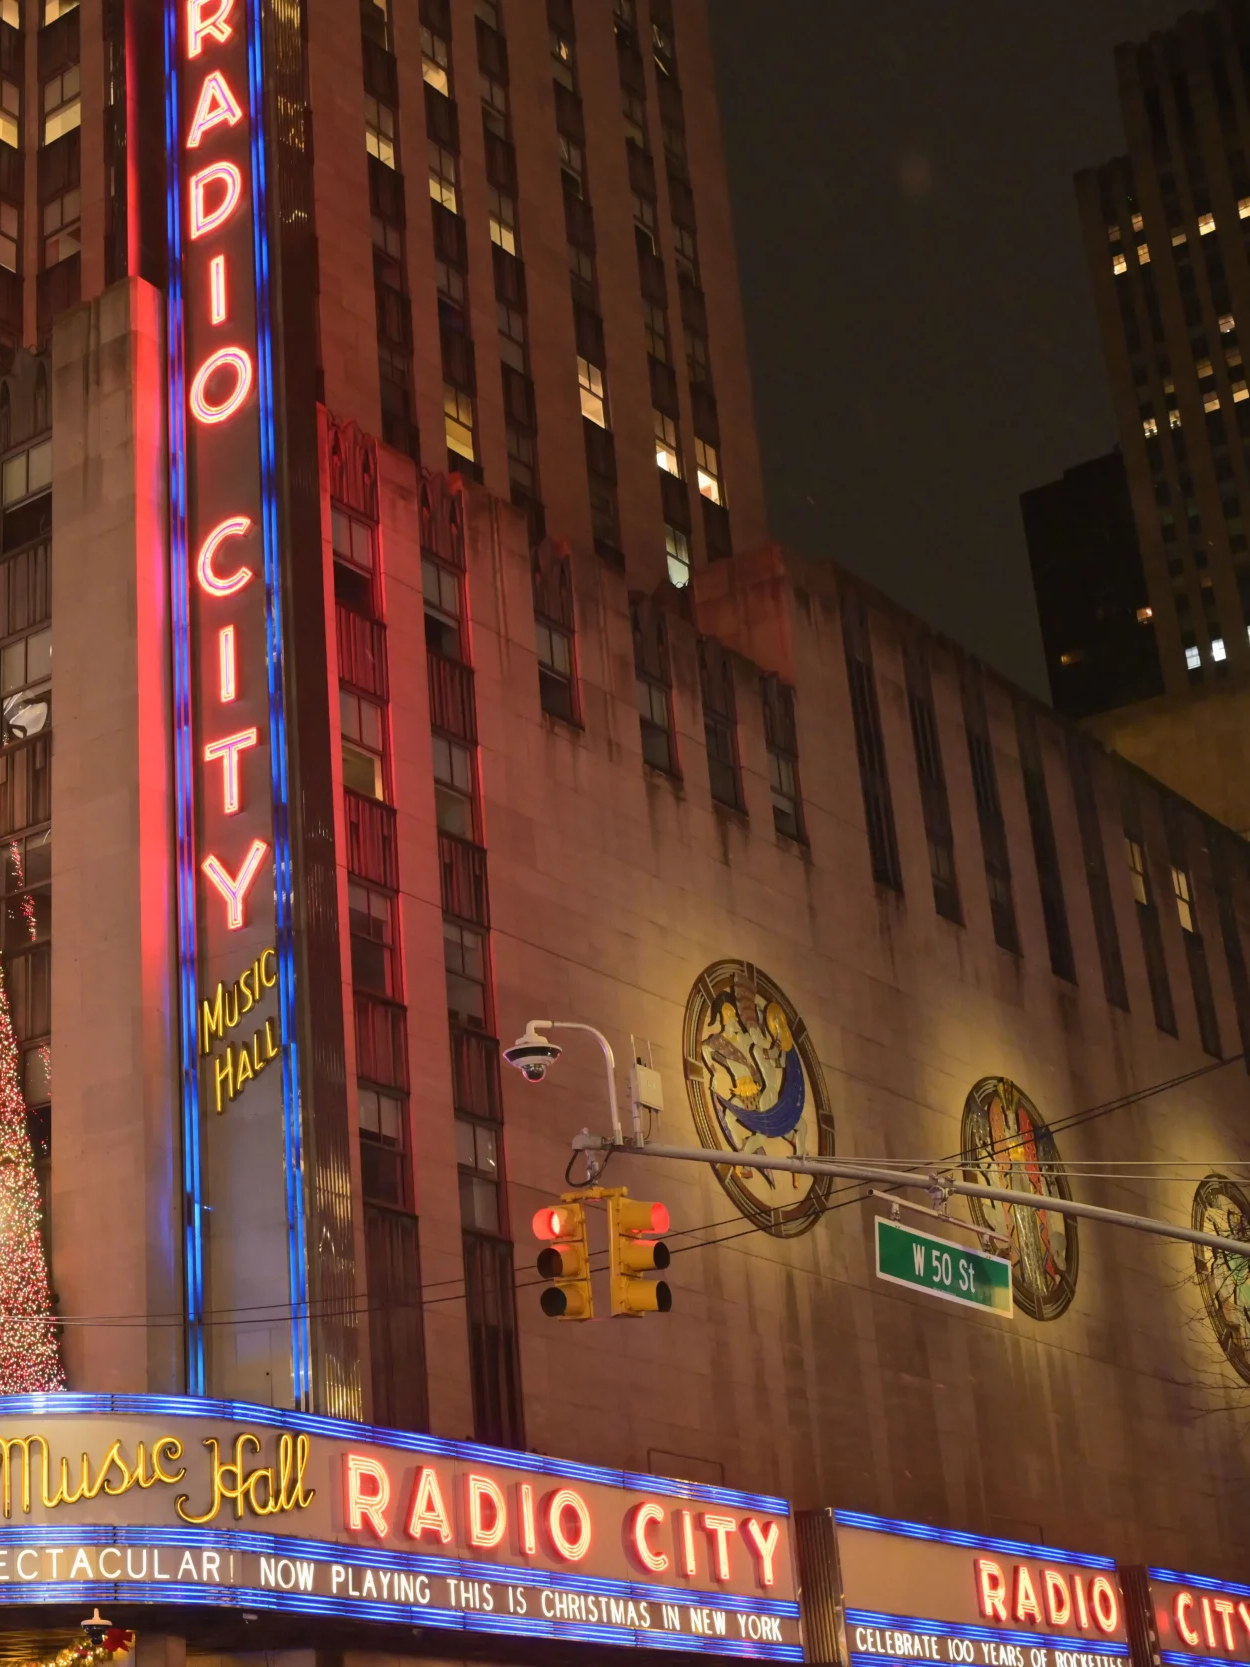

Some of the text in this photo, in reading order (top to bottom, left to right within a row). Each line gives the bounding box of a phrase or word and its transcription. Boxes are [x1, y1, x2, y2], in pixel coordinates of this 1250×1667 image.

[185, 0, 253, 425] RADIO
[197, 515, 268, 931] CITY
[912, 1243, 976, 1294] W 50 St
[176, 1433, 316, 1524] Hall
[348, 1453, 780, 1586] RADIO CITY
[260, 1557, 315, 1591] NOW
[332, 1564, 430, 1604] PLAYING
[448, 1579, 493, 1611] THIS
[509, 1587, 526, 1614] IS
[541, 1591, 650, 1629] CHRISTMAS
[663, 1605, 681, 1631] IN
[691, 1608, 726, 1637] NEW
[738, 1614, 783, 1642] YORK
[979, 1559, 1118, 1633] RADIO
[856, 1627, 939, 1660] CELEBRATE
[948, 1639, 975, 1663] 100
[981, 1643, 1024, 1667] YEARS
[1030, 1649, 1048, 1667] OF
